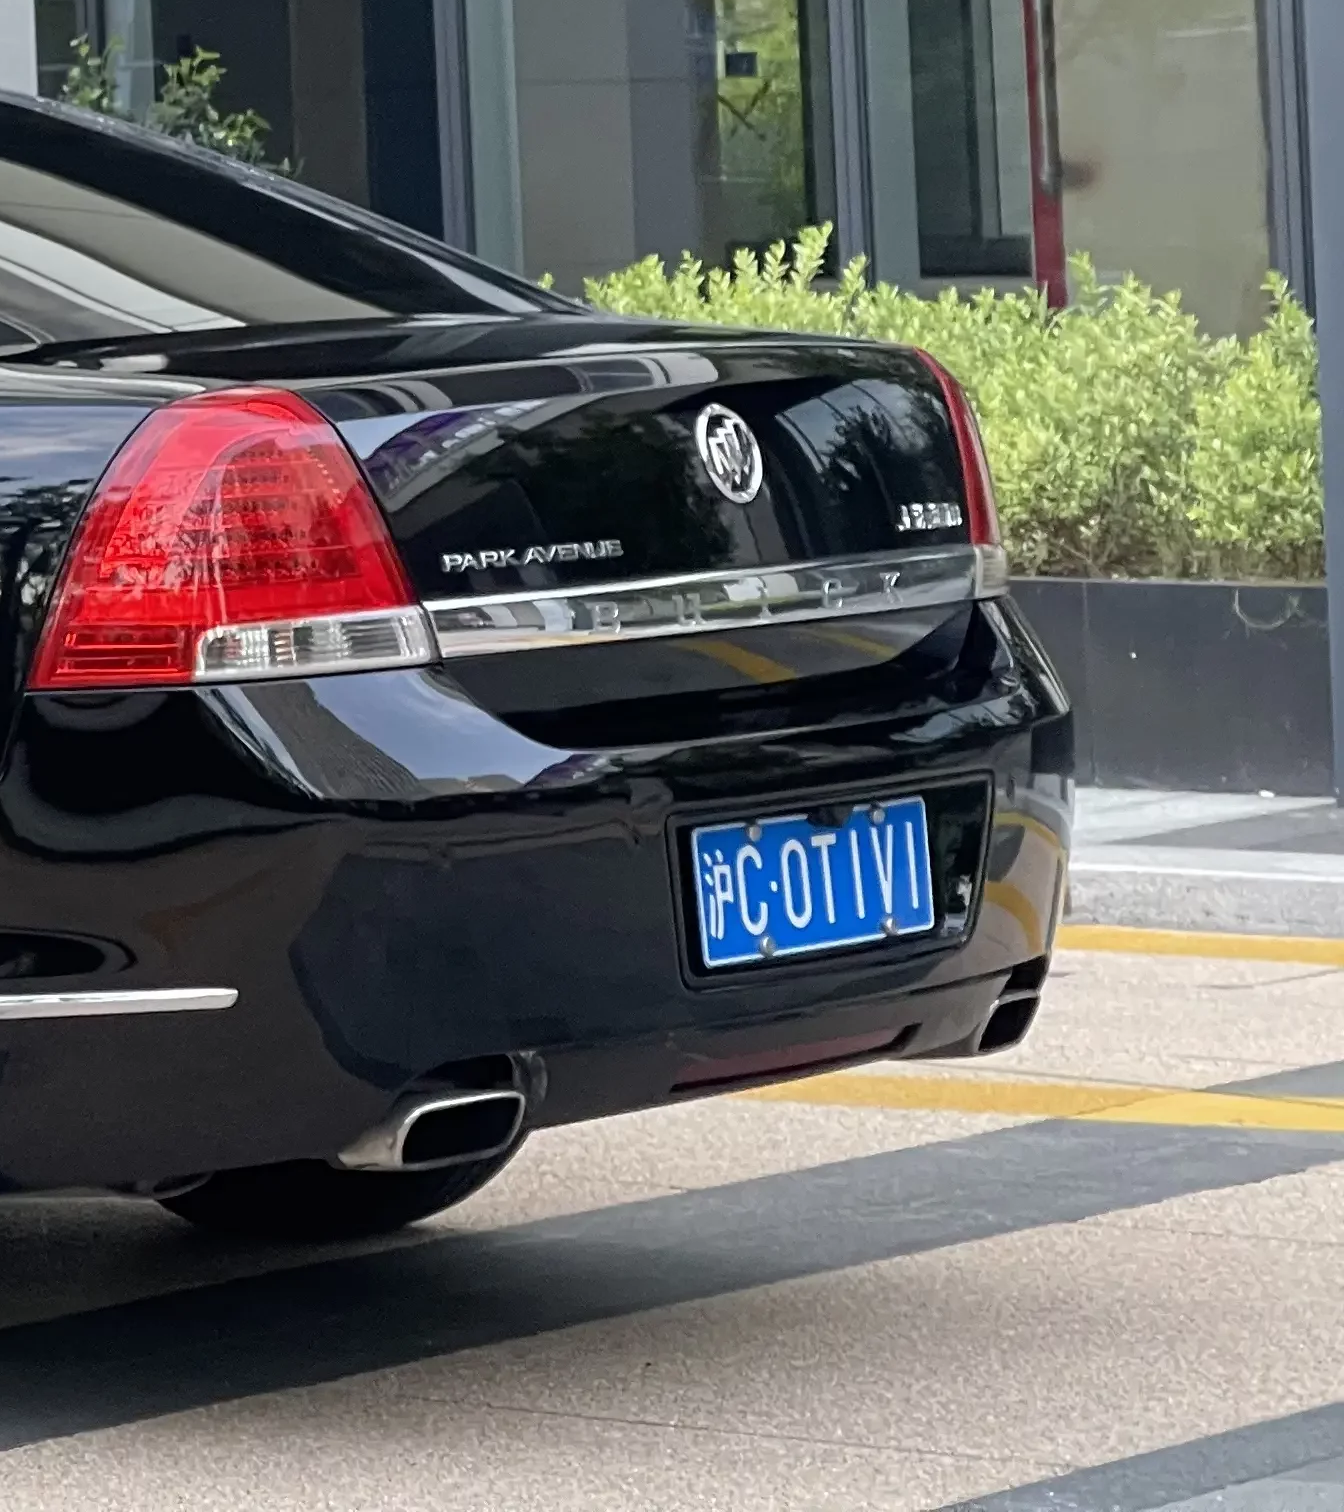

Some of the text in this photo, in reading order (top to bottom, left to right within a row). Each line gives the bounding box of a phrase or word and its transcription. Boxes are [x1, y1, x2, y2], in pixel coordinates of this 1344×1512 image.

[441, 539, 625, 573] PARK AVENUE
[589, 571, 904, 636] BUICK
